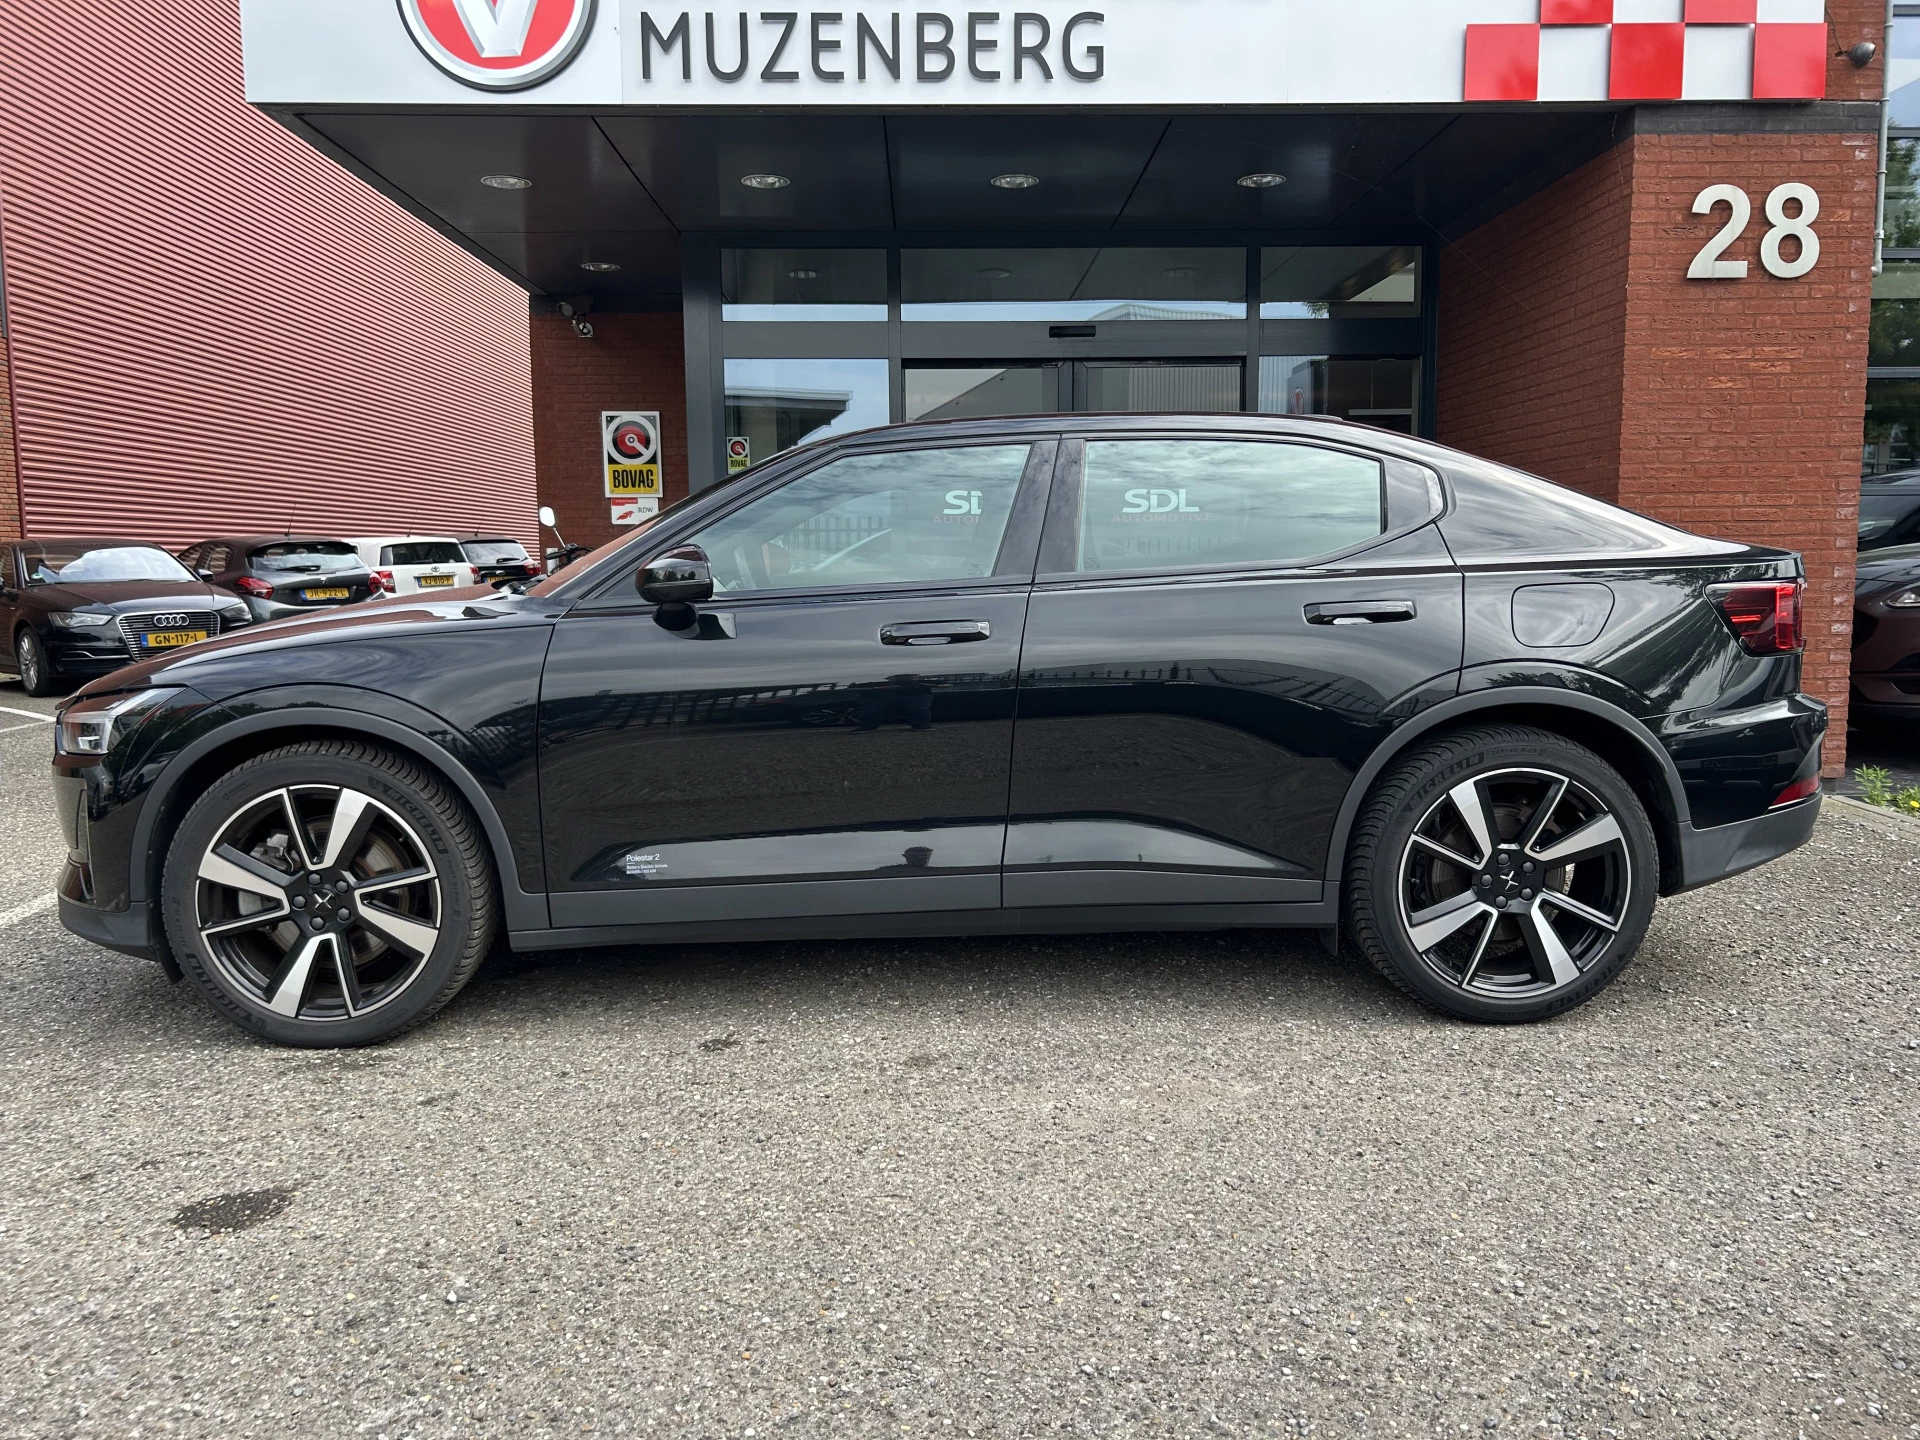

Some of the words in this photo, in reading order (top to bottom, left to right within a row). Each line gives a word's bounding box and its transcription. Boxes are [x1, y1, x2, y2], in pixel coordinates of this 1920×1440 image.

[640, 11, 1106, 83] MUZENBERG
[1686, 182, 1821, 280] 28
[731, 459, 748, 468] BOVAG
[612, 469, 655, 489] BOVAG
[1122, 488, 1200, 513] SDL
[1111, 513, 1213, 523] AUTOMOTIVE
[310, 588, 346, 598] JR-922-L
[154, 633, 198, 645] GN-117-L
[1404, 753, 1482, 810] MICHELIN
[386, 786, 447, 853] MICHELIN
[626, 854, 655, 862] Polestar
[655, 853, 660, 861] 2
[187, 953, 250, 1025] MICHELIN
